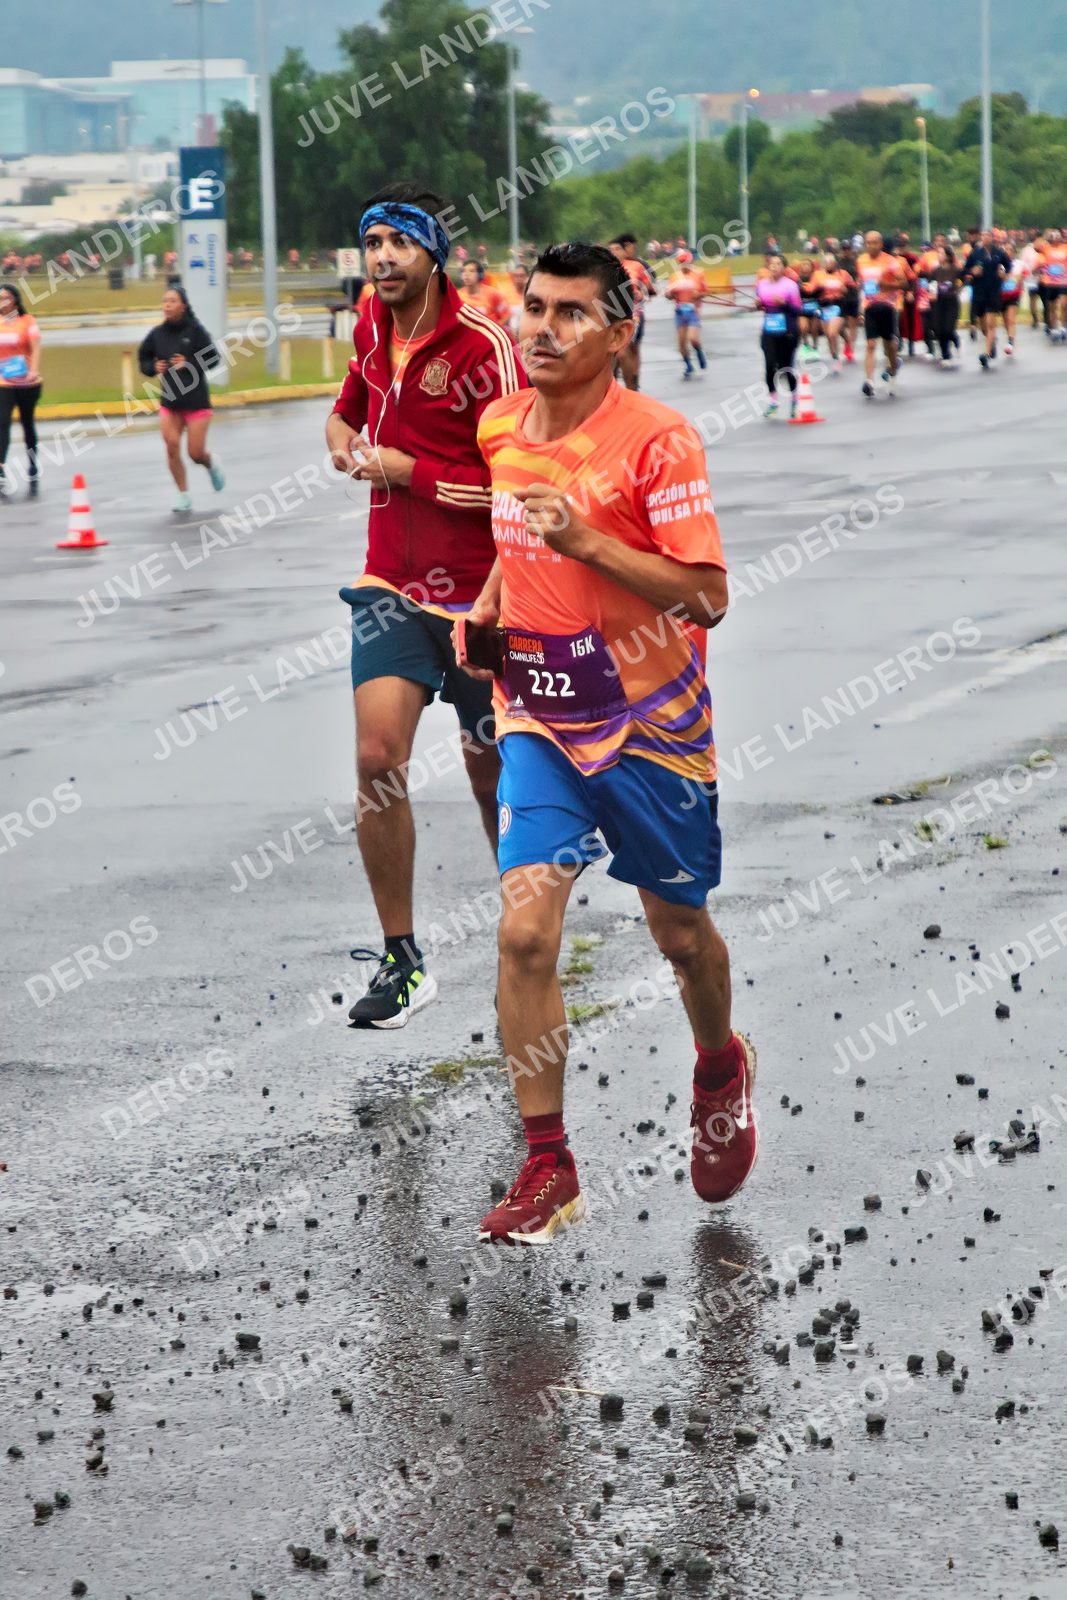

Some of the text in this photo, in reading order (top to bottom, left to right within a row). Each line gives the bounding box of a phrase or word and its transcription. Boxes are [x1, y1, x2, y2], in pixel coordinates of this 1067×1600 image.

[189, 177, 214, 212] E
[492, 490, 528, 522] CAR
[508, 634, 544, 654] CARRERA
[570, 634, 596, 658] 15K
[528, 669, 576, 698] 222
